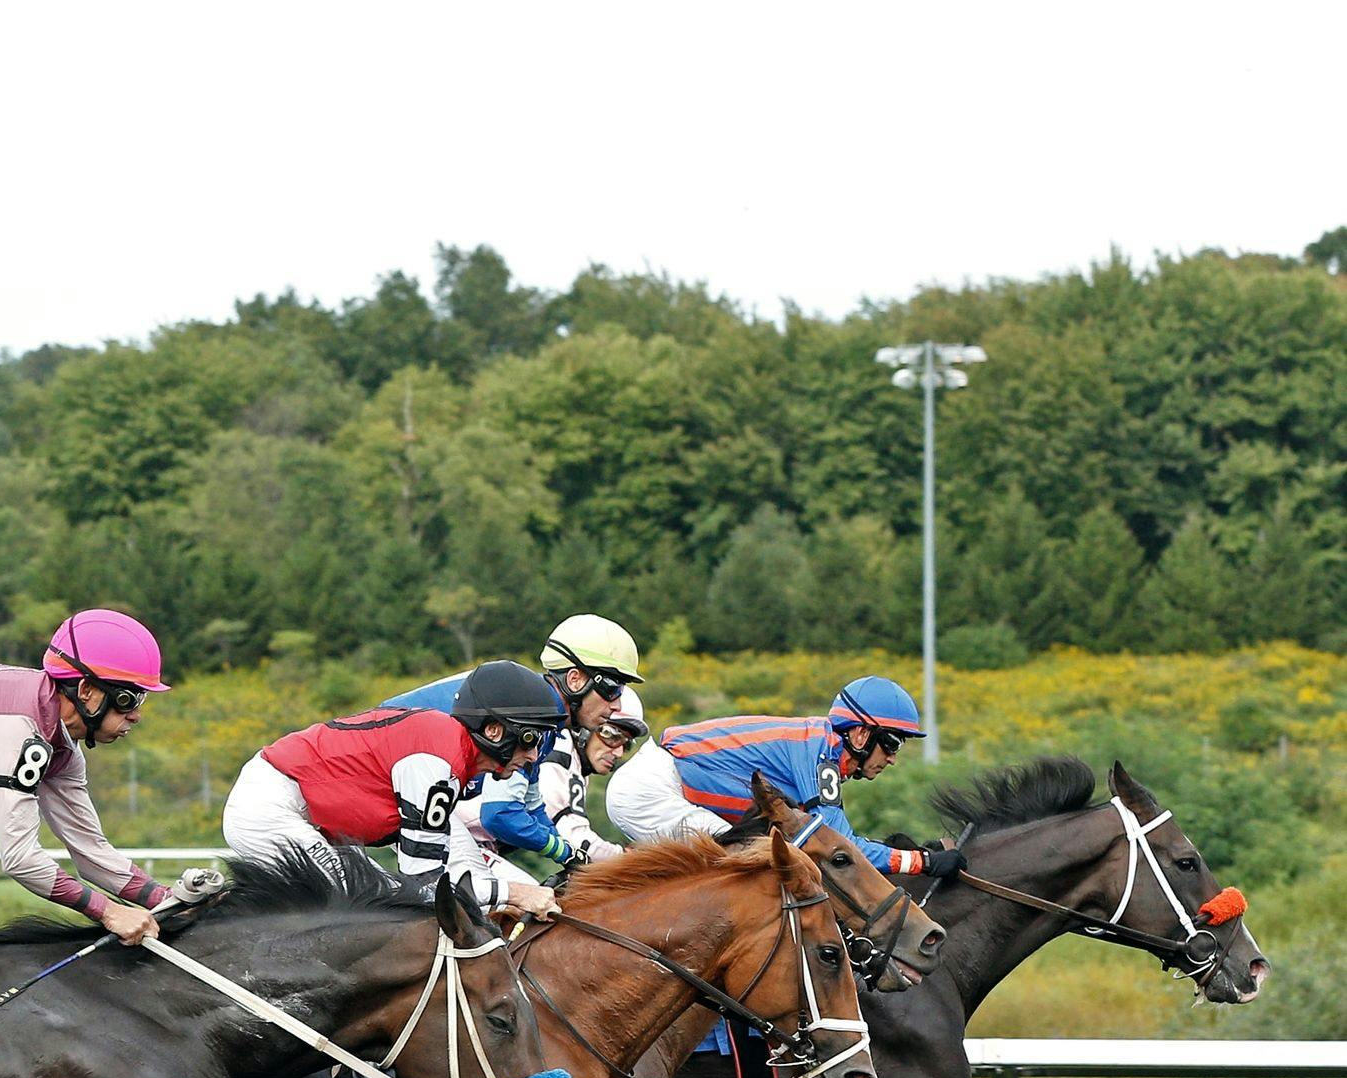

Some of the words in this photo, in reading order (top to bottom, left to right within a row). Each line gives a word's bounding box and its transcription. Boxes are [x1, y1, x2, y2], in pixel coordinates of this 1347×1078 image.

[17, 744, 49, 787] 8
[571, 784, 585, 813] 2
[821, 767, 839, 801] 3
[426, 791, 450, 828] 6
